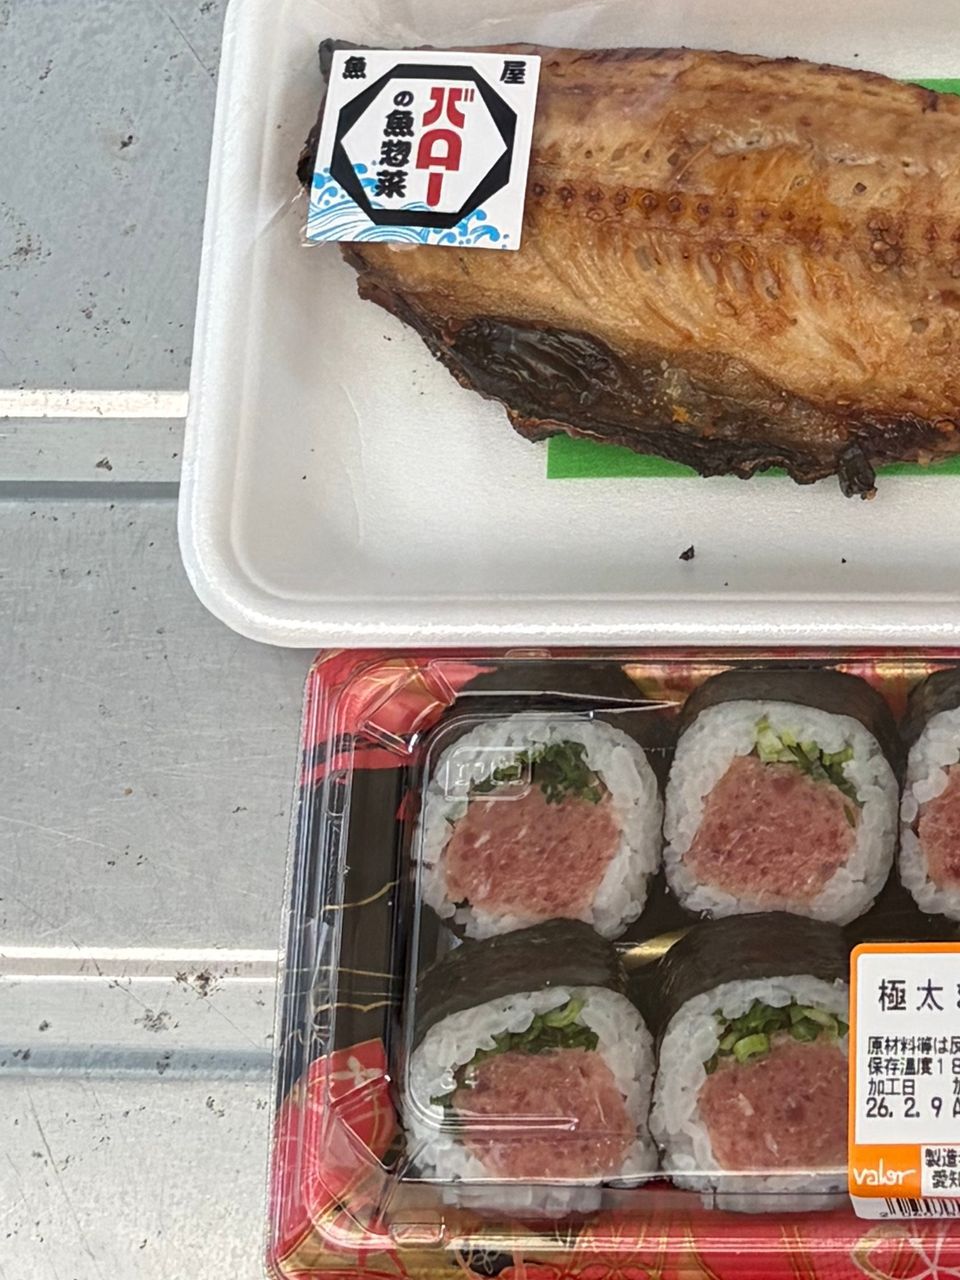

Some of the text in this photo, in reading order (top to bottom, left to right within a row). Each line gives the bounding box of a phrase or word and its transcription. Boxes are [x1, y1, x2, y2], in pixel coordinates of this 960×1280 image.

[341, 55, 527, 85] 魚 屋
[374, 90, 415, 199] の魚惣菜
[867, 1077, 916, 1097] 加工日
[852, 1158, 917, 1186] valor
